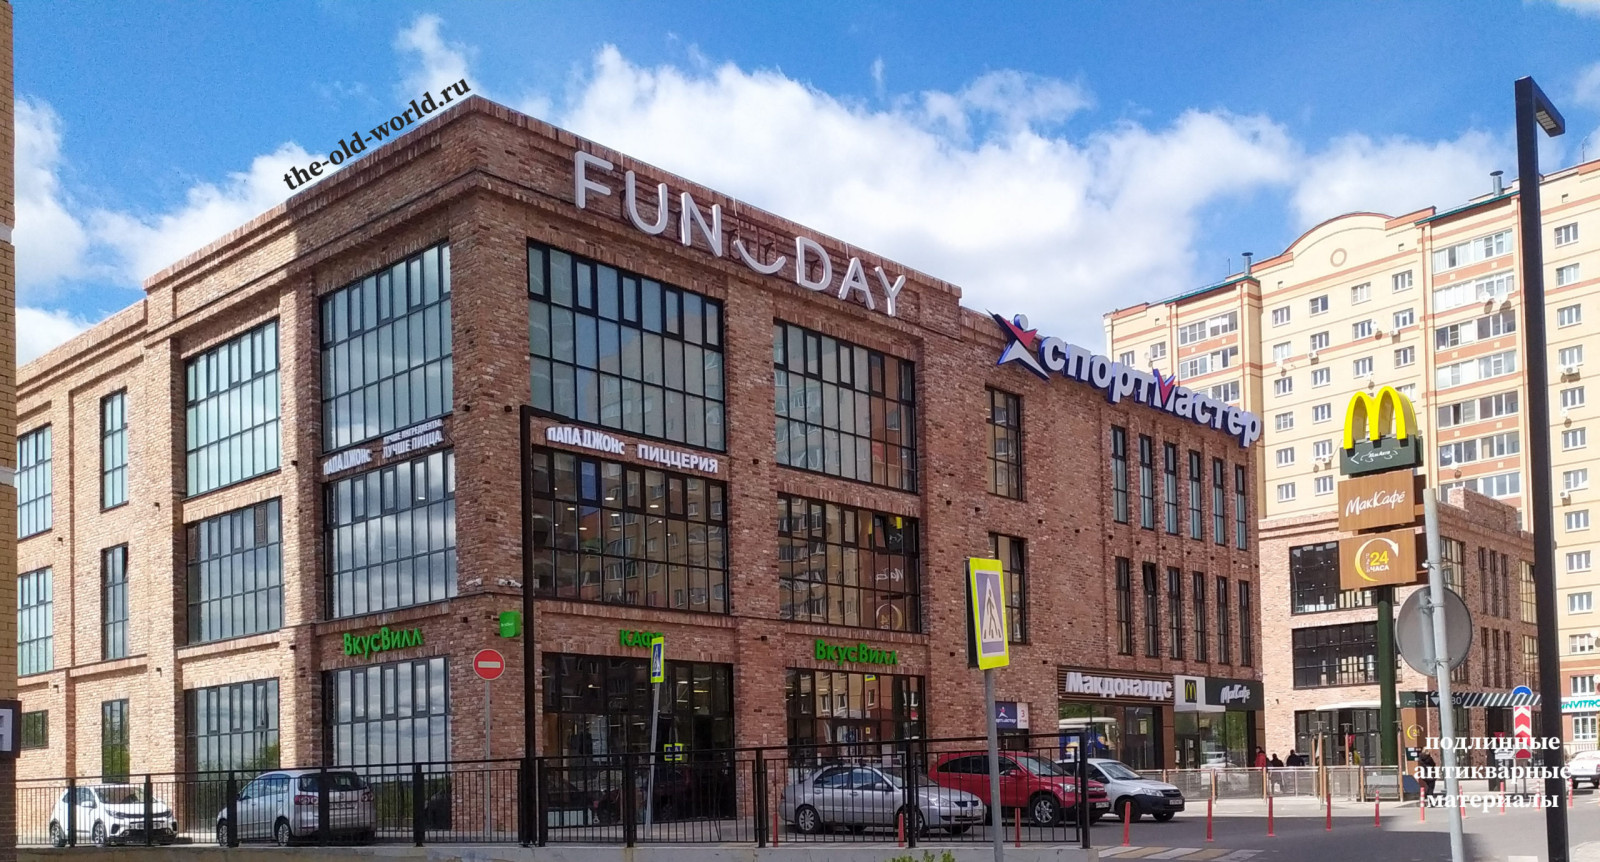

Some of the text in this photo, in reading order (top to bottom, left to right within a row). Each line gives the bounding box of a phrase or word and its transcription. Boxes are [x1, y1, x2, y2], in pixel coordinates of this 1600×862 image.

[574, 150, 906, 318] FUN DAY
[382, 439, 412, 459] ЛУЧШЕ
[637, 443, 719, 473] ПИЦЦЕРИЯ
[1370, 550, 1389, 566] 24
[1370, 564, 1390, 572] ЧАСА
[343, 626, 423, 659] ВкусВилл
[815, 638, 898, 666] ВкусВилл
[1065, 672, 1173, 700] Макдоналдс
